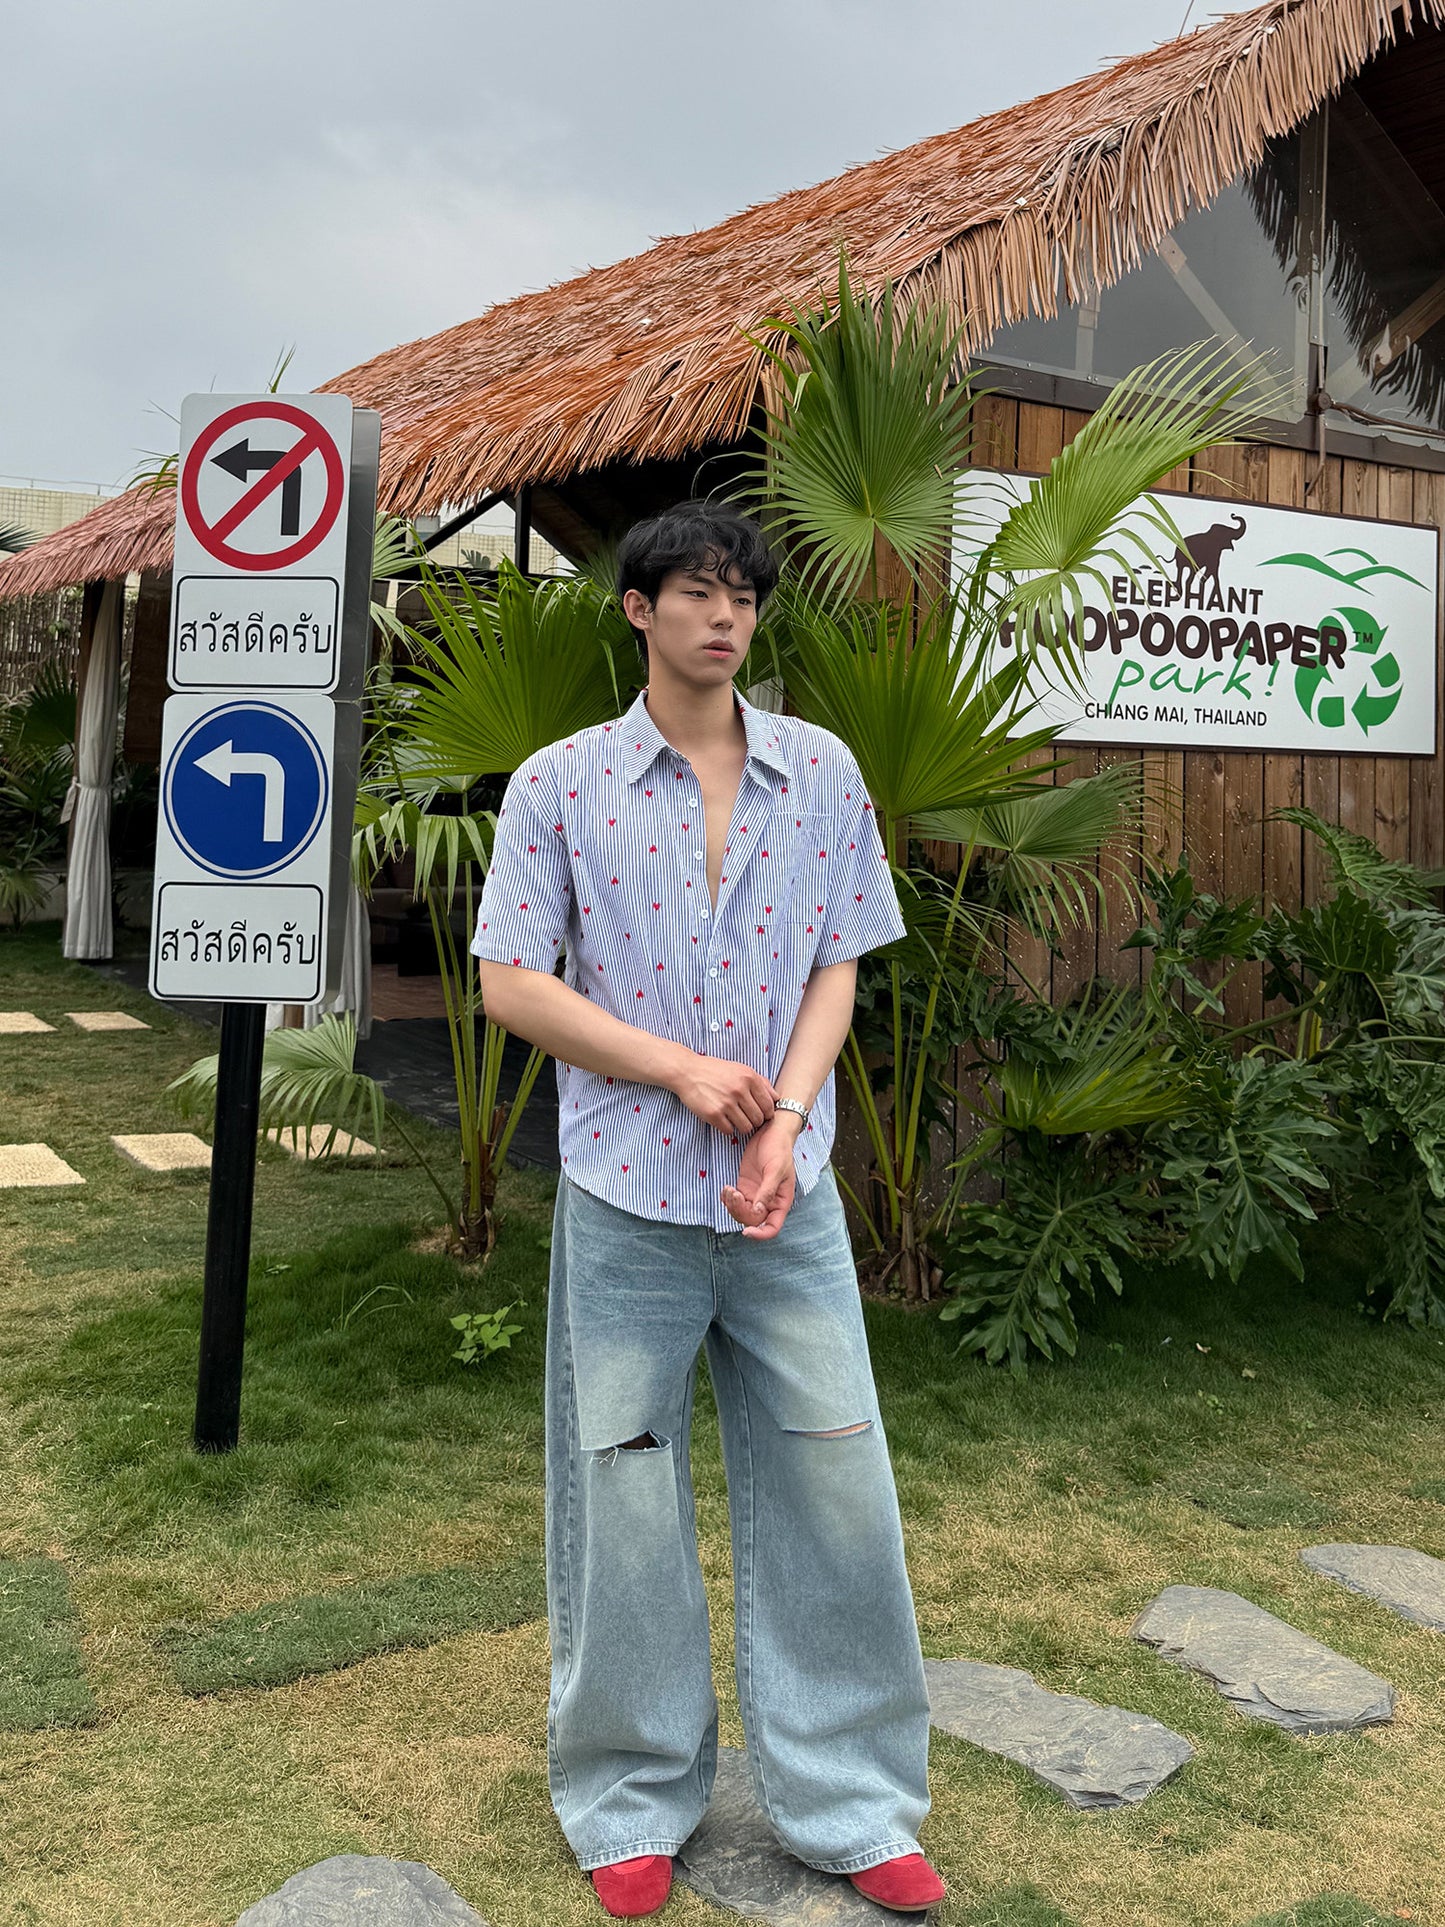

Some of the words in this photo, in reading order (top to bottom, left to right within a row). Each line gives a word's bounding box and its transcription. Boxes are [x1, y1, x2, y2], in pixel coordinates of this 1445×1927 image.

[1112, 575, 1263, 615] ELEPHANT
[179, 610, 332, 654] สวัสดีครับ
[1107, 639, 1280, 716] park!
[1084, 702, 1149, 721] CHIANG
[1154, 706, 1188, 726] MAI,
[1194, 708, 1267, 727] THAILAND
[160, 919, 316, 965] สวัสดีครับ
